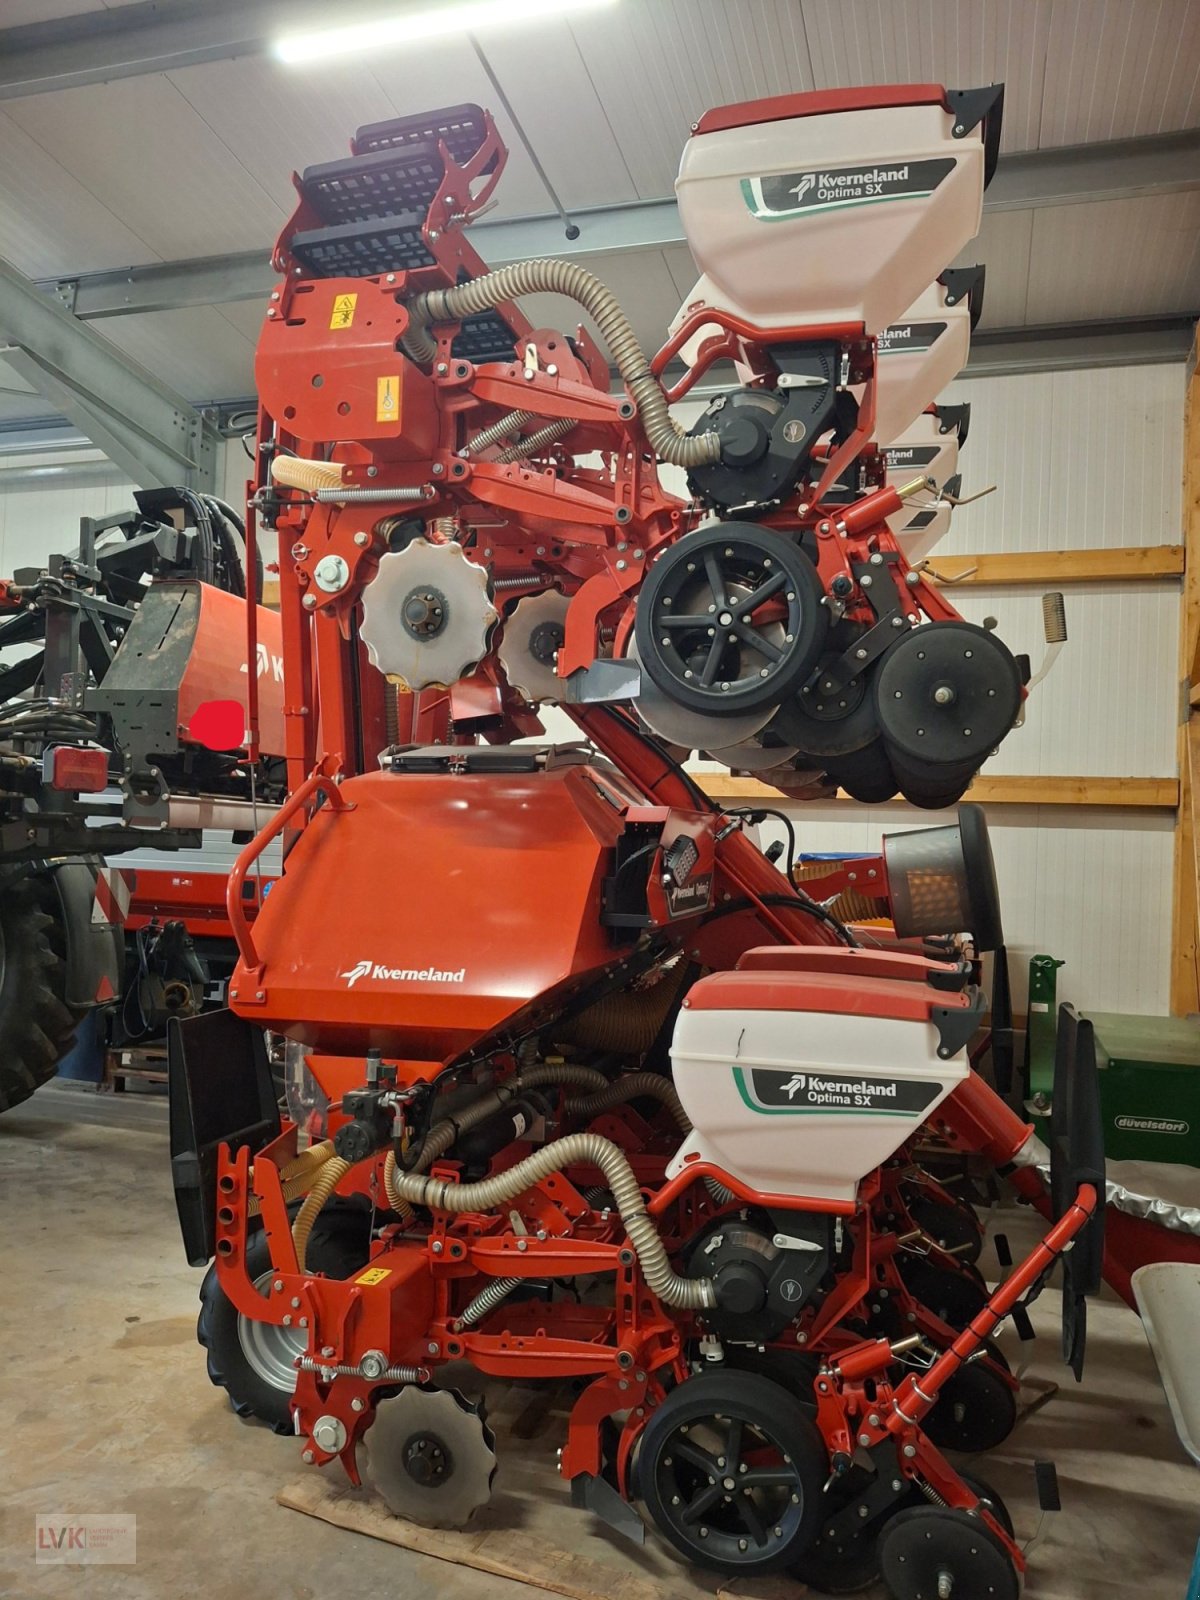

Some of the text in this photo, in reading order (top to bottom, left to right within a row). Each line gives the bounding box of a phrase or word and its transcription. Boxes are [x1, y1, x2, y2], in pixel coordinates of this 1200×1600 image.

[818, 166, 909, 188] Kverneland
[817, 183, 883, 201] Optima SX
[877, 327, 912, 339] eland
[886, 449, 913, 458] eland
[372, 965, 466, 982] Kverneland
[808, 1077, 897, 1097] Kverneland
[807, 1091, 872, 1106] Optima SX
[1118, 1118, 1185, 1131] düvelsdorf
